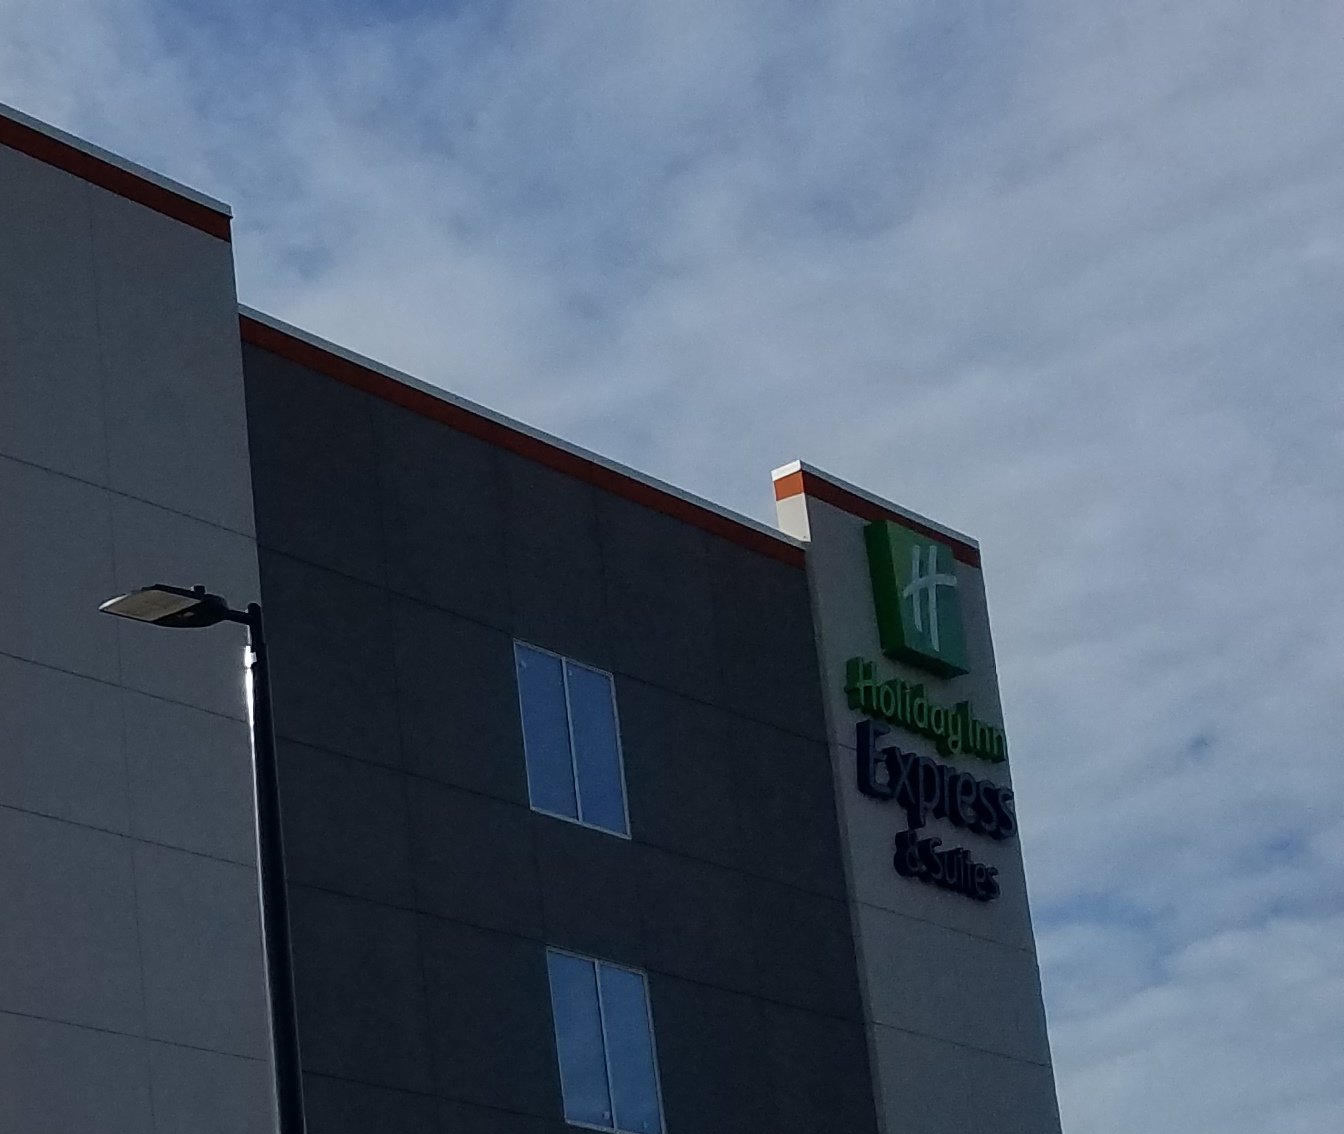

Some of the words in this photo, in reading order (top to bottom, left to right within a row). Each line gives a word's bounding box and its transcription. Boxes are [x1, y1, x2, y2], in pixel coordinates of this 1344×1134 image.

[845, 656, 965, 758] Holiday
[965, 701, 1007, 762] Inn
[856, 720, 1016, 840] Express
[895, 830, 925, 877] &
[920, 837, 1001, 901] Suites
